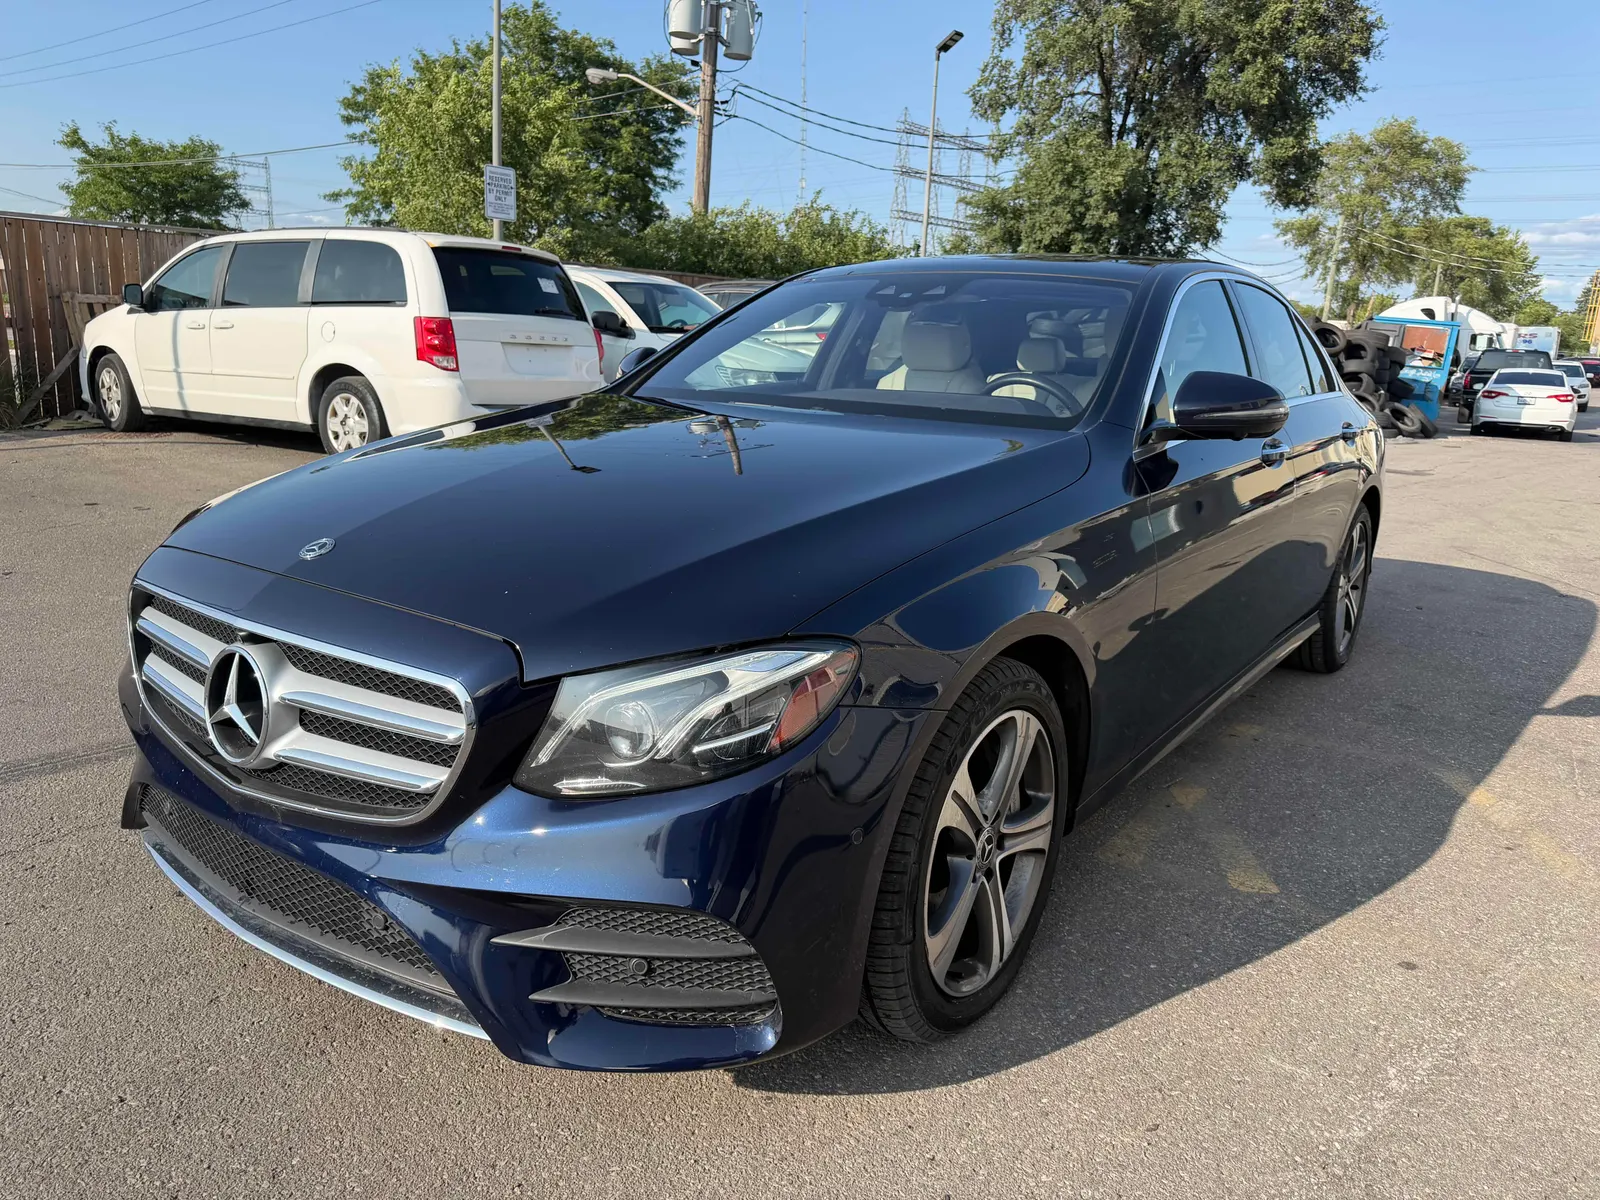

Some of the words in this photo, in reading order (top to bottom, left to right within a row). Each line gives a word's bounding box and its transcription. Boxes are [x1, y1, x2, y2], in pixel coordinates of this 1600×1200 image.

[488, 175, 512, 185] RESERVED
[490, 182, 509, 190] PARKING
[496, 189, 512, 197] PERMIT
